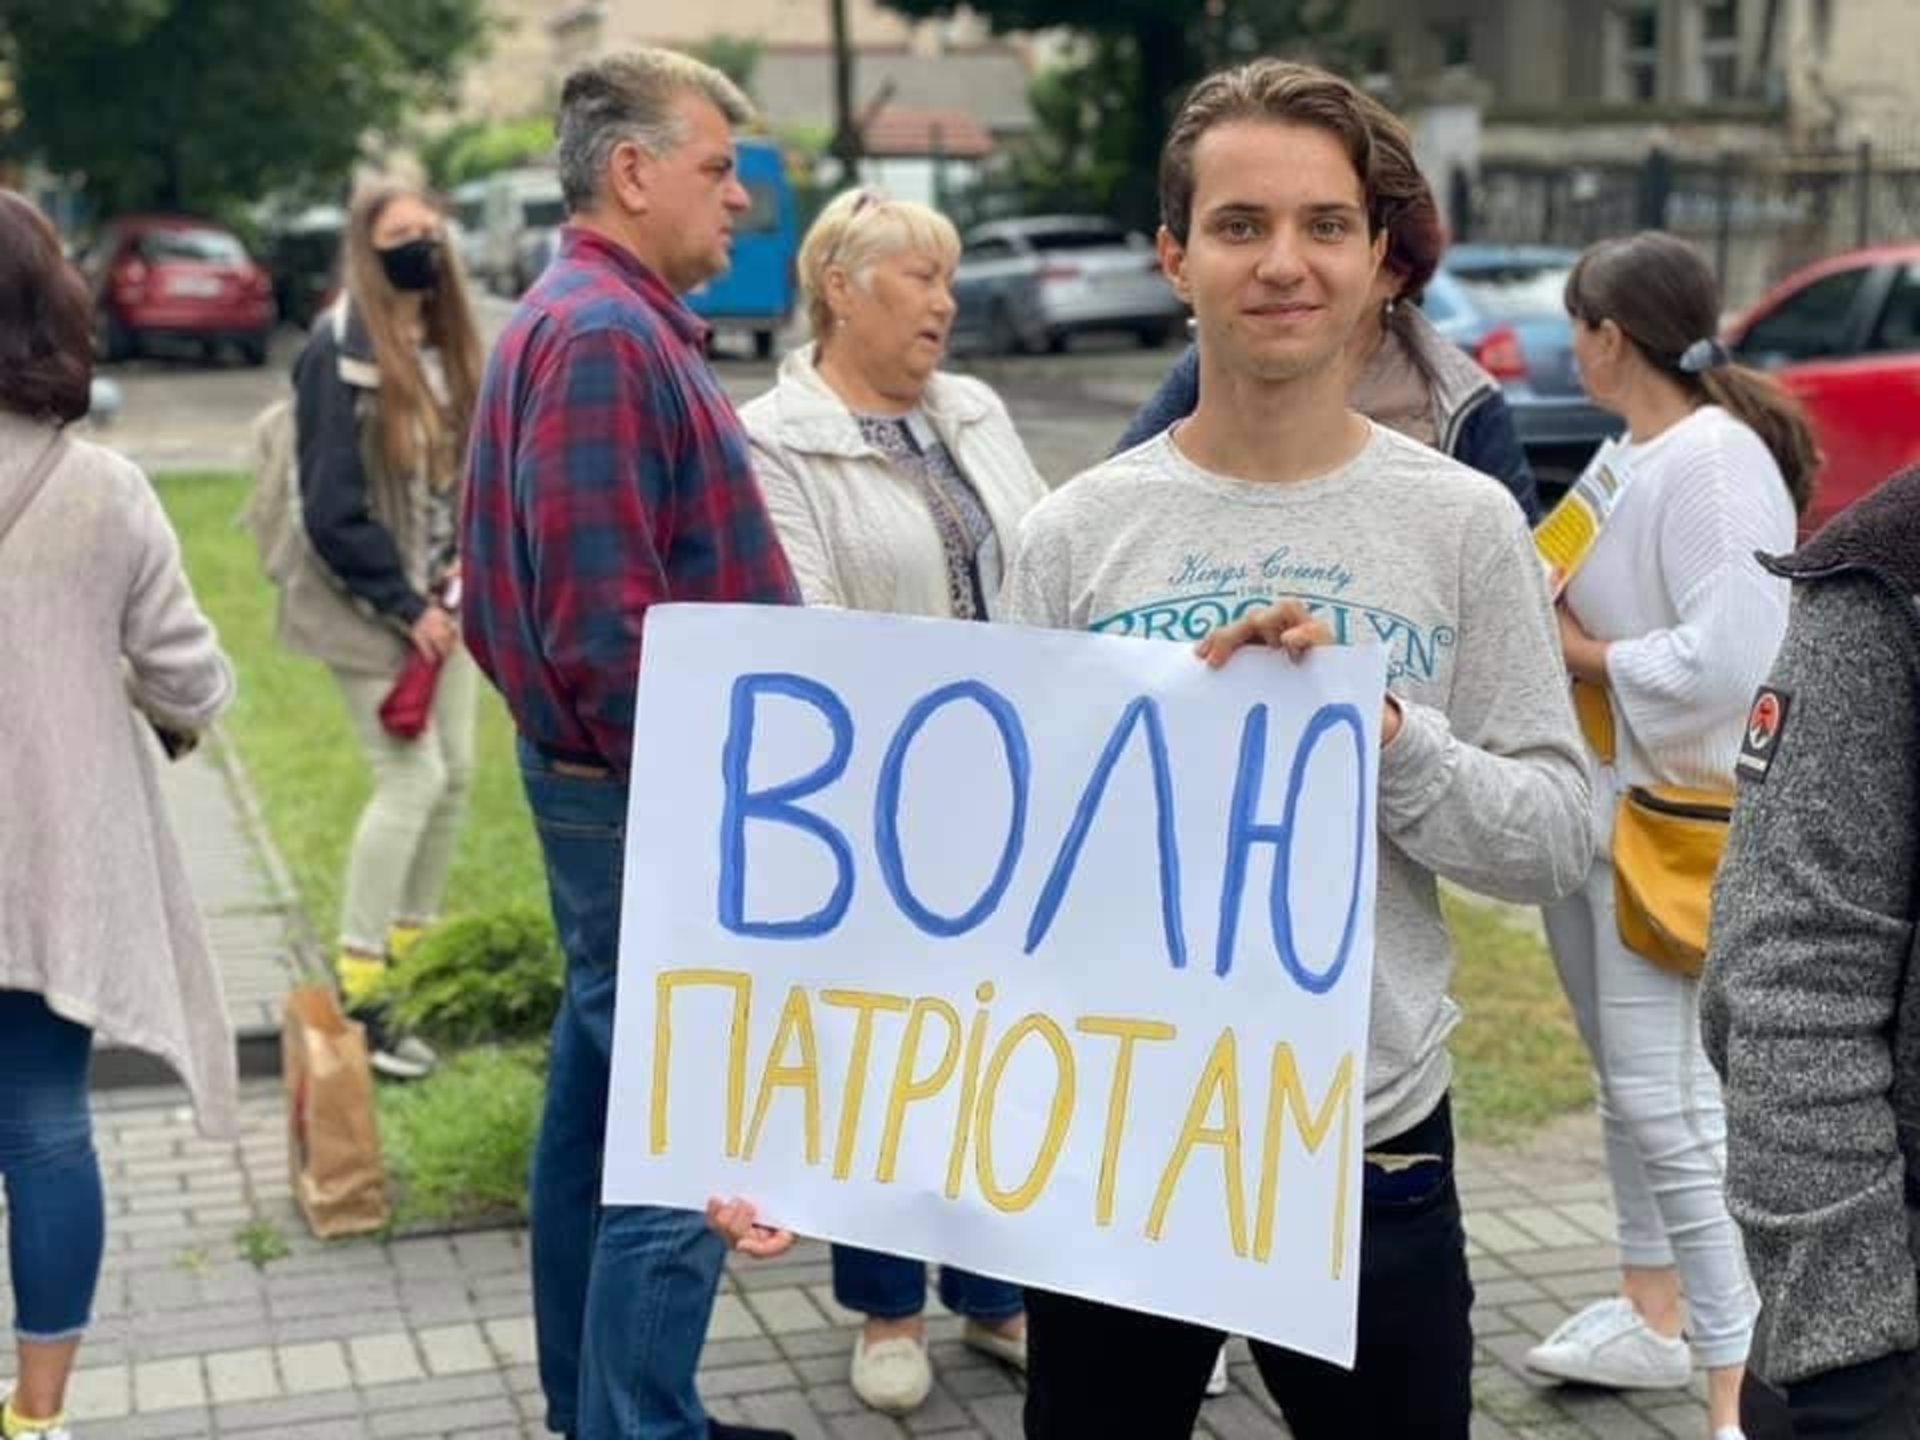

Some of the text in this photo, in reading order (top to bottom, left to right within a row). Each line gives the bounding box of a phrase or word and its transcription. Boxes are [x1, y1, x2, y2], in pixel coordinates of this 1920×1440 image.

[1168, 544, 1353, 594] Kings County
[718, 672, 1366, 994] ВОЛЮ
